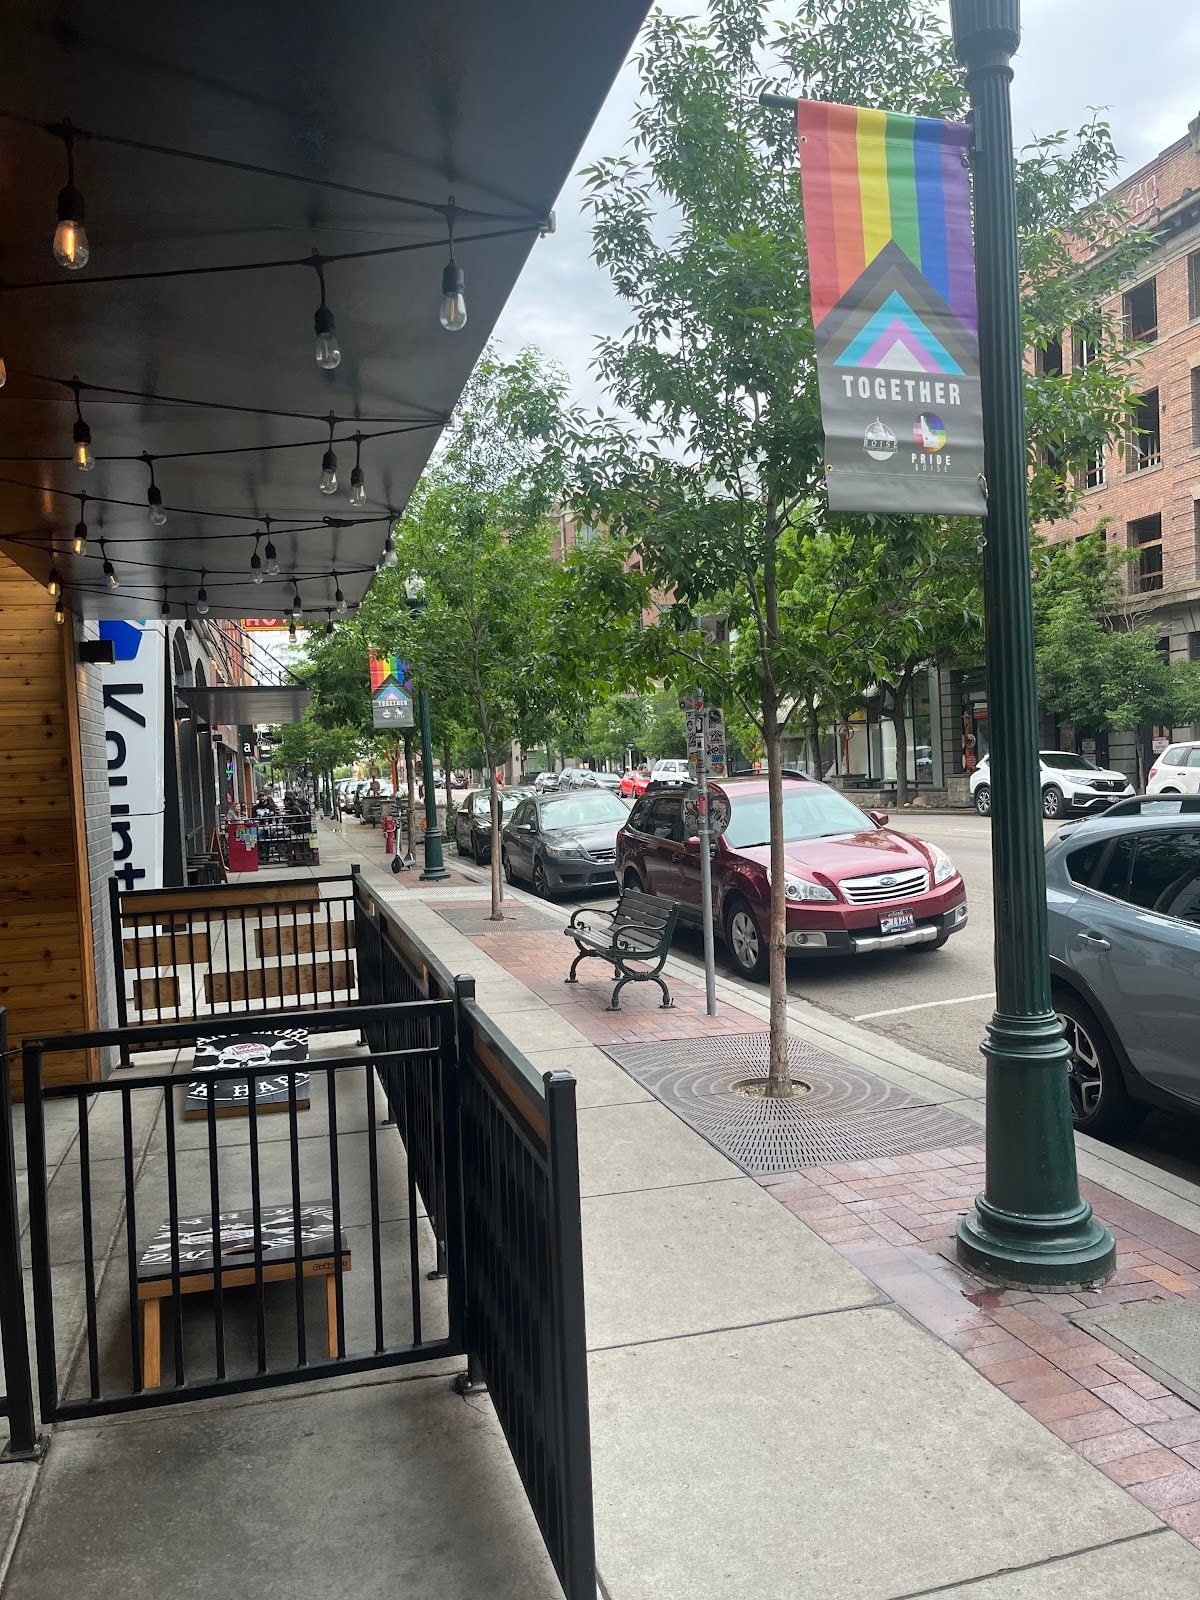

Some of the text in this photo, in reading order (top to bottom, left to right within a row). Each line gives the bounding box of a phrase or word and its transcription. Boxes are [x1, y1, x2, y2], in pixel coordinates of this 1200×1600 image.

[841, 374, 961, 406] TOGETHER
[863, 439, 899, 449] BOISE
[911, 453, 951, 466] PRIDE
[915, 463, 948, 473] BOISE
